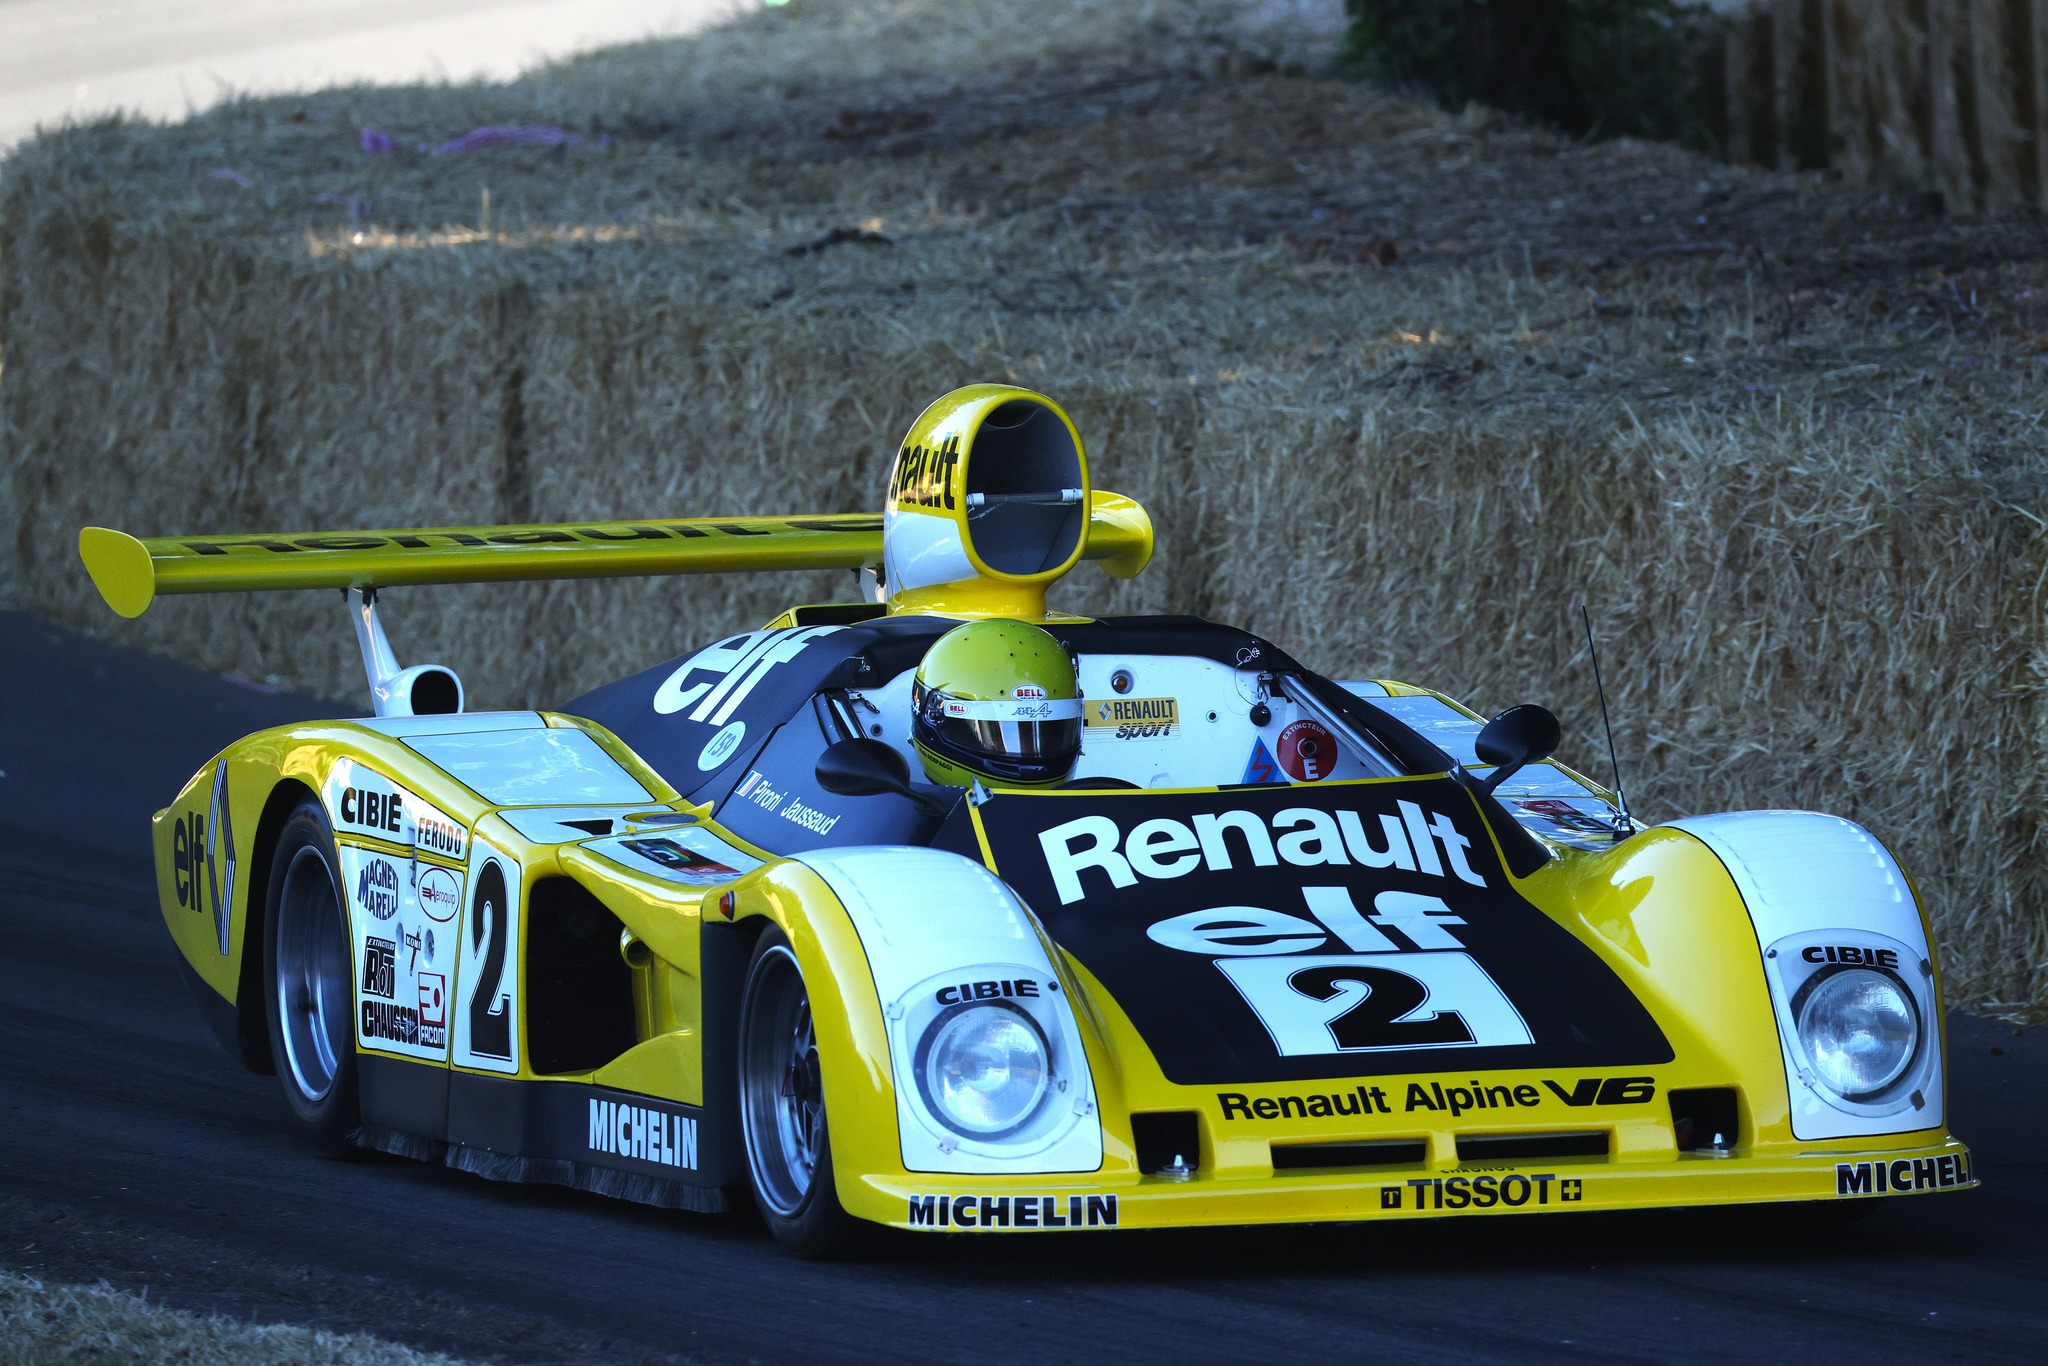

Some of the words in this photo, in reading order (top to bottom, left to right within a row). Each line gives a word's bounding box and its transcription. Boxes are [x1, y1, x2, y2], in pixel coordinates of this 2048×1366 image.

[653, 625, 853, 727] elf
[1016, 689, 1042, 697] BELL
[949, 705, 965, 713] BELL
[1114, 700, 1174, 720] RENAULT
[707, 730, 734, 758] 159
[1115, 719, 1174, 740] sport
[1282, 722, 1327, 741] EXTINCTEUR
[1303, 758, 1319, 780] E
[748, 779, 789, 812] Pironi
[781, 797, 842, 835] Jaussaud
[417, 817, 462, 855] FERODO
[1037, 799, 1488, 906] Renault
[174, 810, 204, 913] elf
[359, 858, 399, 892] MAGNETI
[357, 884, 399, 920] MARELLI
[1146, 886, 1468, 956] elf
[469, 856, 511, 1062] 2
[362, 1000, 419, 1045] CHAUSSON
[1287, 964, 1477, 1052] 2
[1217, 1086, 1392, 1121] Renault
[1404, 1079, 1541, 1117] Alpine
[1541, 1076, 1655, 1107] V6
[589, 1098, 698, 1170] MICHELIN
[1407, 1174, 1555, 1209] TISSOT
[908, 1194, 1119, 1228] MICHELIN
